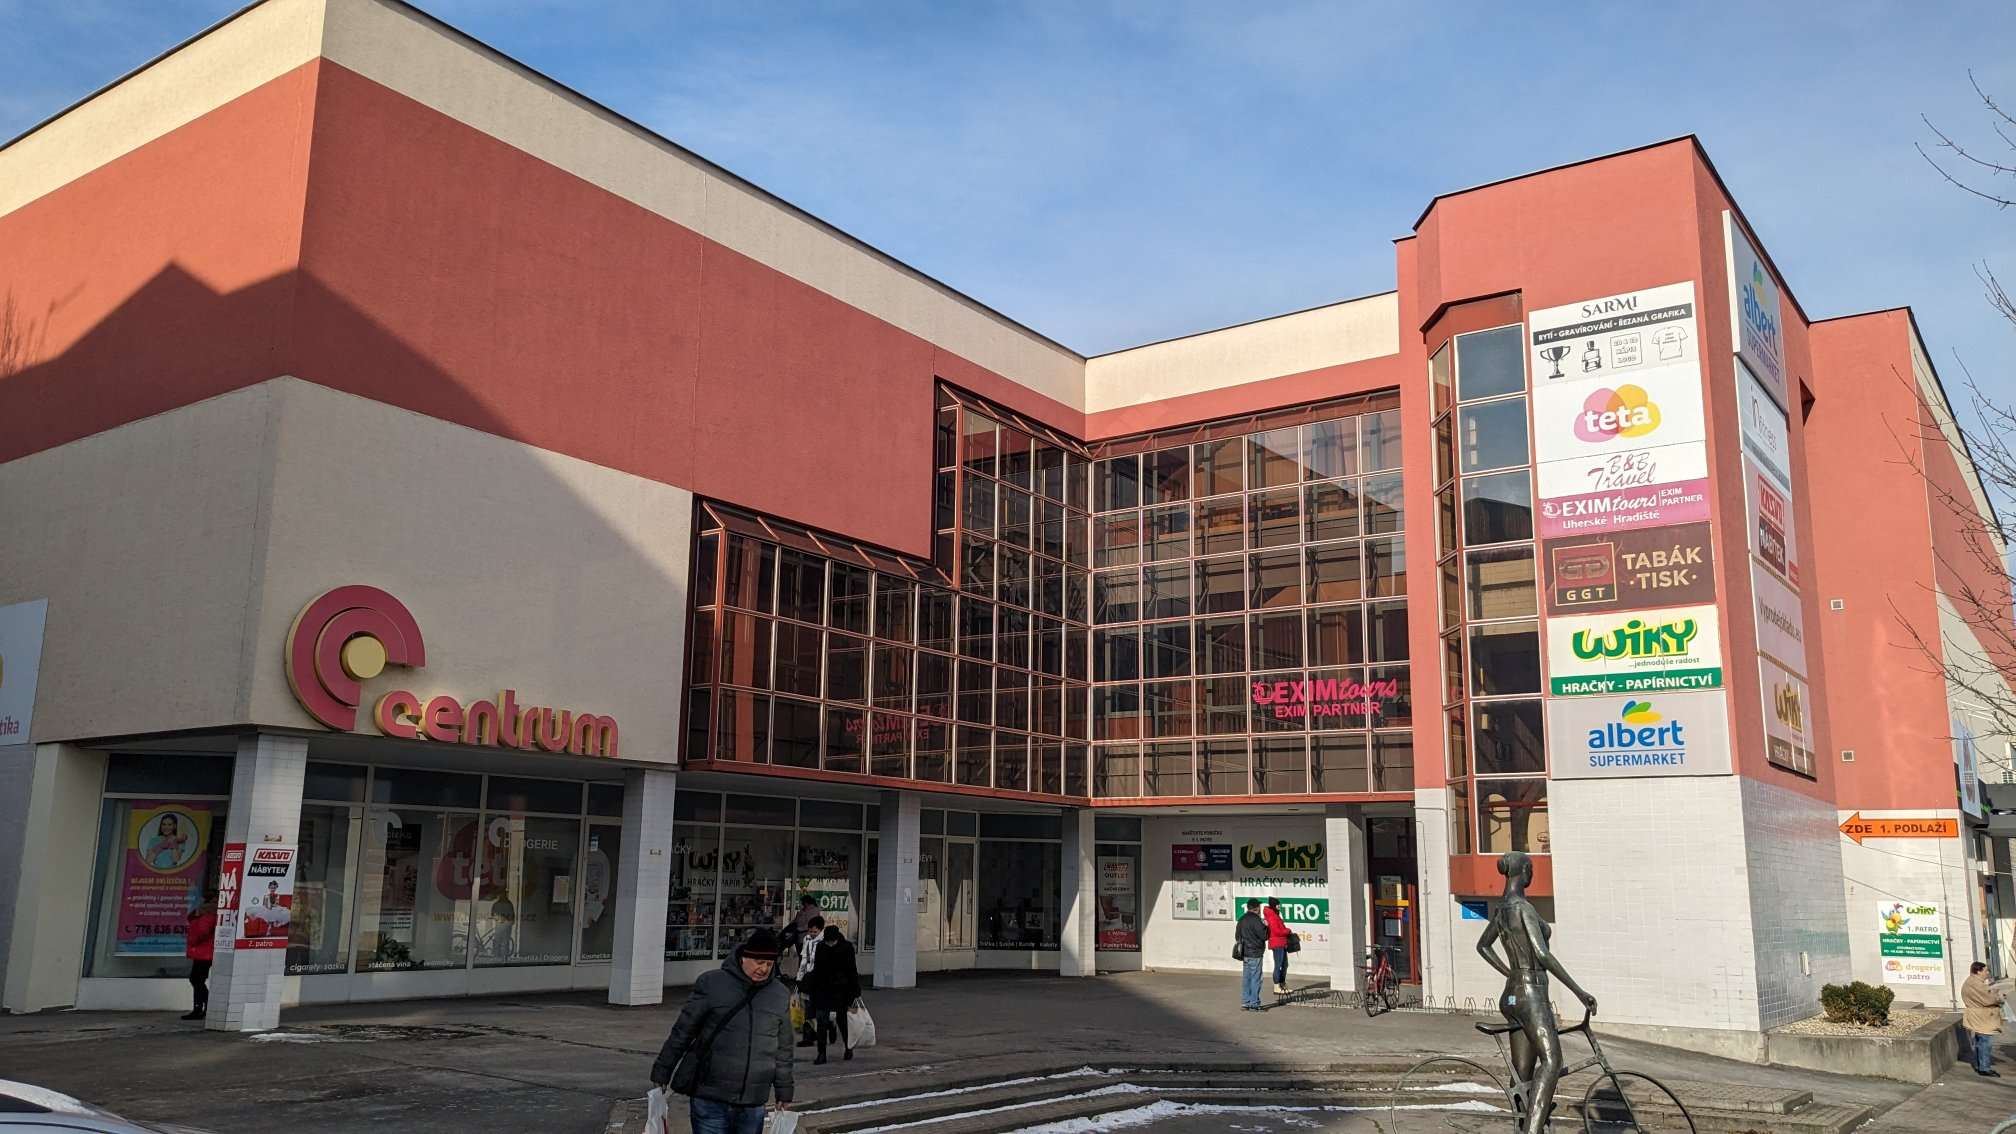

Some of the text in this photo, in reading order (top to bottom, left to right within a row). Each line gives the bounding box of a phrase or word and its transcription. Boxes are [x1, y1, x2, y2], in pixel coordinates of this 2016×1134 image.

[1581, 296, 1638, 318] SARMI
[1538, 308, 1686, 341] RYTÍ GRAVÍROVÁNÍ ŘEZANÁ GRAFIKA
[1743, 282, 1777, 357] albert
[1584, 404, 1651, 433] teta
[1609, 452, 1650, 474] B&B
[1586, 462, 1656, 490] Travel
[1661, 487, 1682, 498] EXIM
[1661, 494, 1703, 505] PARTNER
[1562, 511, 1660, 530] Uherské Hradiště
[1622, 545, 1703, 571] TABÁK
[1675, 657, 1700, 666] radost
[1562, 679, 1615, 693] HRAČKY
[1625, 673, 1713, 690] PAPÍRNICTVÍ
[1275, 702, 1381, 718] EXIM PARTNER
[374, 689, 619, 757] centrum
[1588, 720, 1685, 749] albert
[1589, 752, 1686, 767] SUPERMARKET
[1845, 821, 1947, 834] ZDE 1. PODLAŽÍ
[257, 850, 291, 860] KASVO
[251, 864, 287, 875] NÁBYTEK
[1240, 876, 1284, 888] HRAČKY
